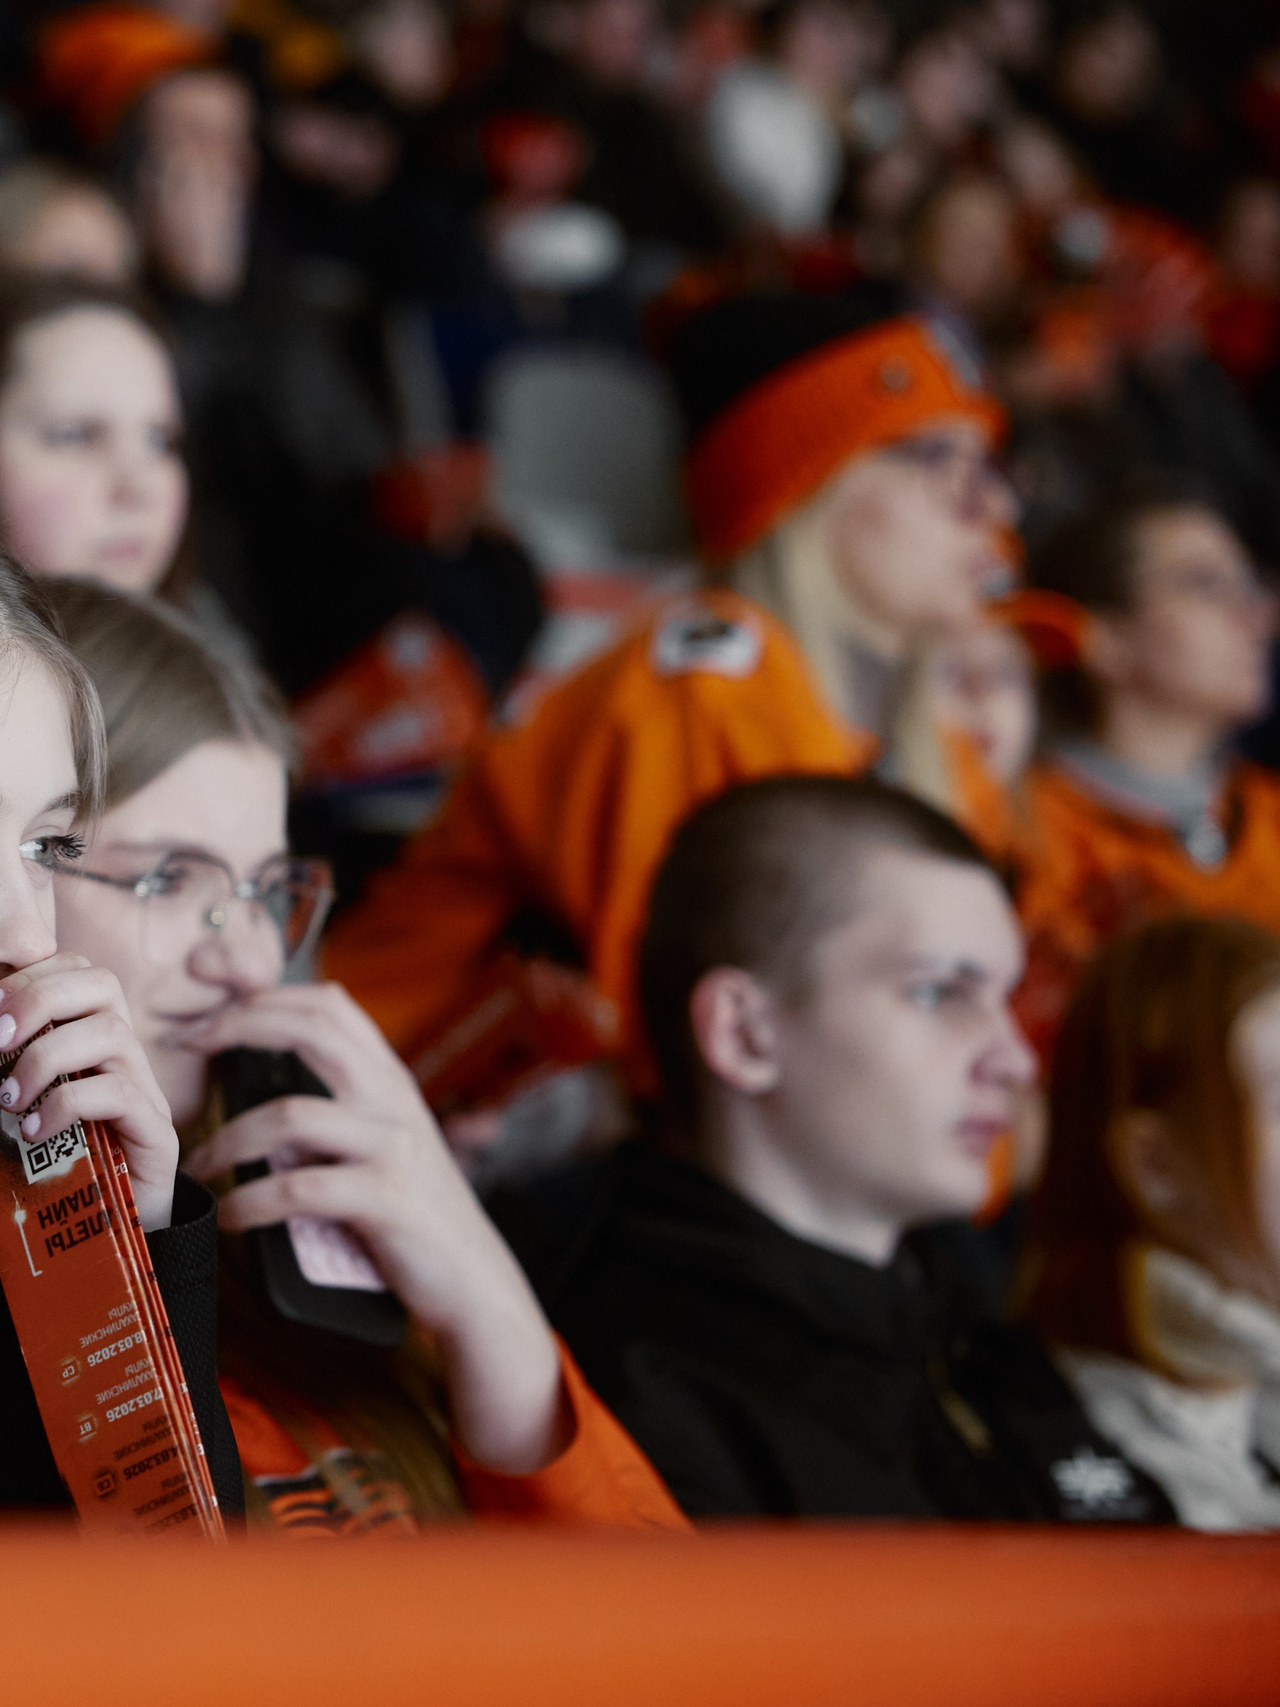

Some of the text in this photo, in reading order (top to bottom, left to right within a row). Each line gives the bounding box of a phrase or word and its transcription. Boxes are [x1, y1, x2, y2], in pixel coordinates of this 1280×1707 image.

[79, 1311, 142, 1349] АХАЛИНСКИЕ
[124, 1355, 155, 1376] КУЛЫ
[96, 1367, 158, 1404] АХАЛИНСКИЕ
